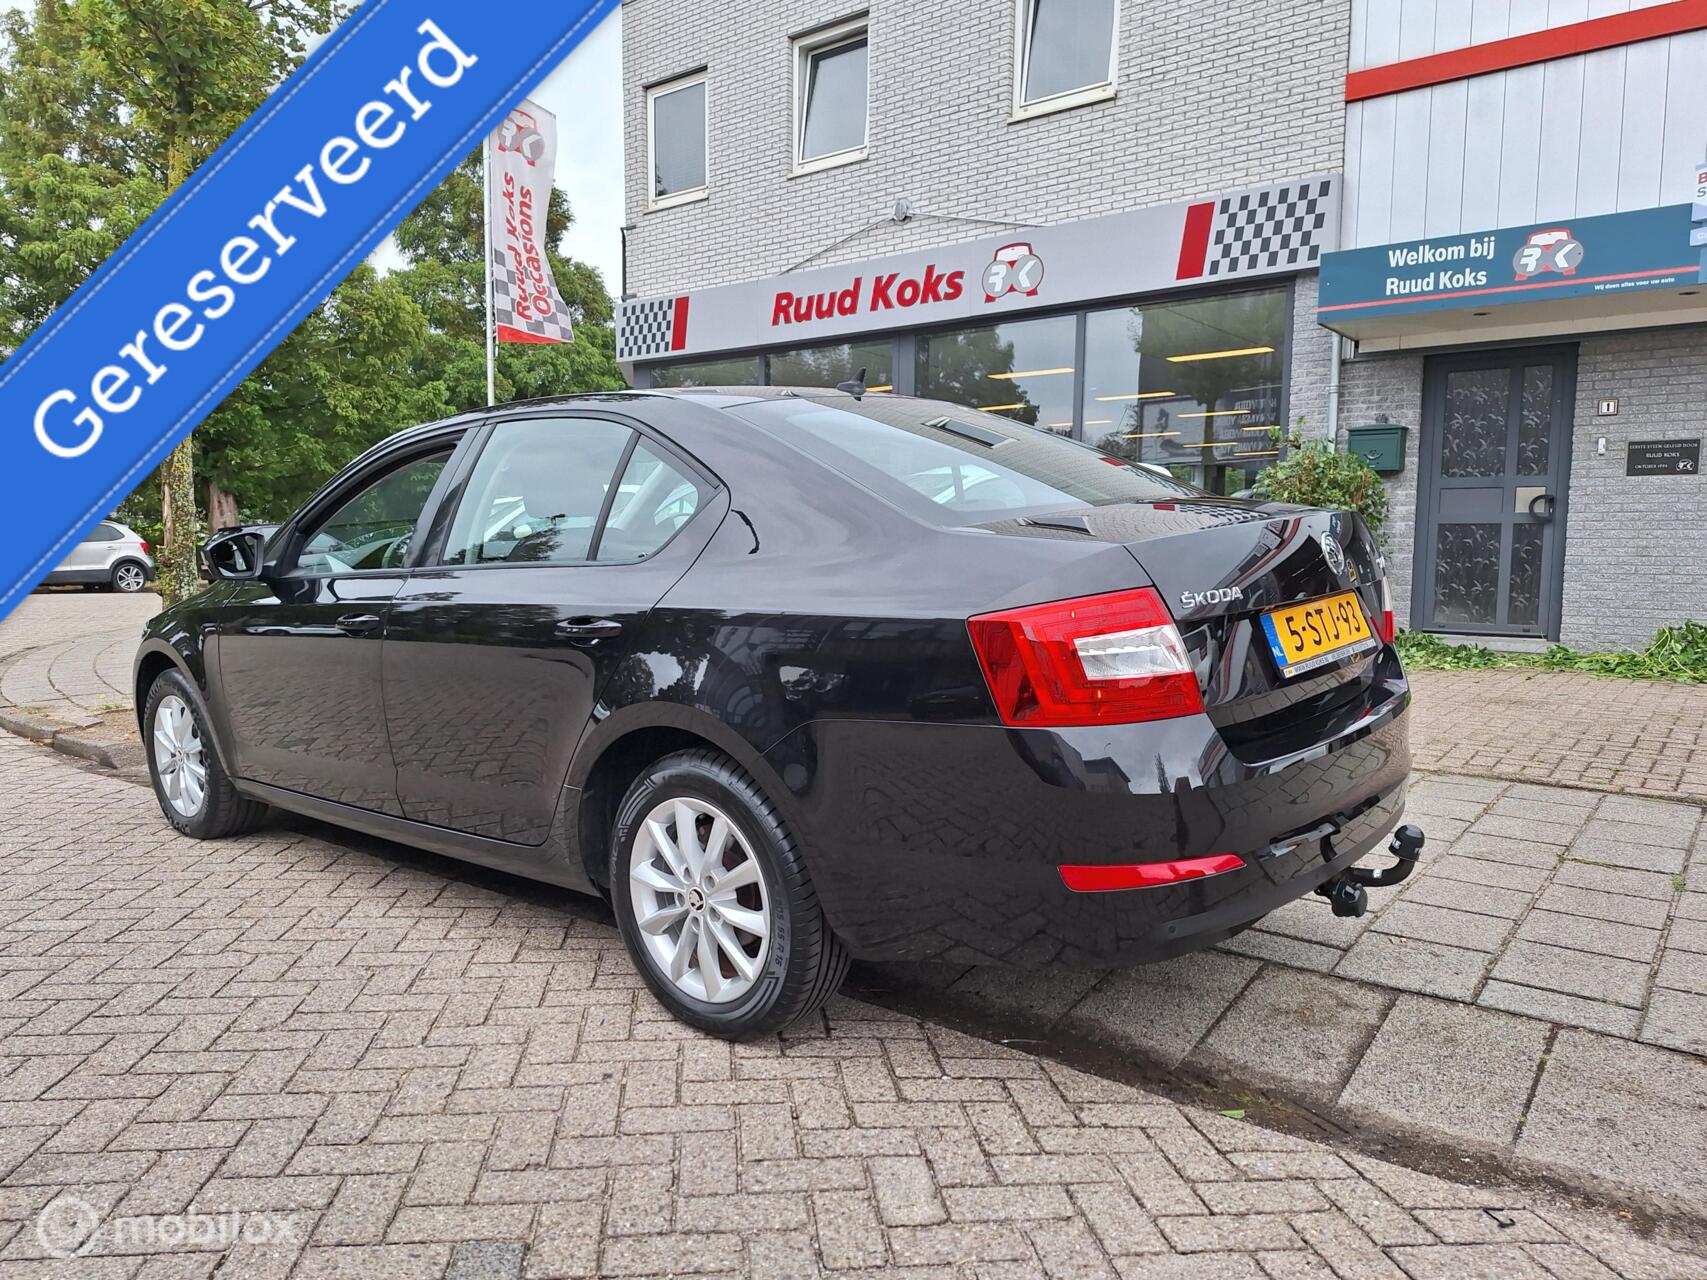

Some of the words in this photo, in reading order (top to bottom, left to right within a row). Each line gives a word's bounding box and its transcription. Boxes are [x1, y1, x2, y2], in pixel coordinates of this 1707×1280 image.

[502, 171, 519, 242] Koks
[518, 185, 552, 316] Occasions
[1388, 245, 1465, 268] Welkom
[1469, 236, 1496, 260] bij
[507, 244, 533, 321] Ruud
[771, 276, 863, 326] Ruud
[869, 264, 966, 312] Koks
[1385, 274, 1434, 296] Ruud
[1439, 267, 1488, 290] Koks
[1181, 585, 1244, 609] ŠKODA
[1271, 646, 1284, 657] NL
[1284, 600, 1361, 652] 5-STJ-93
